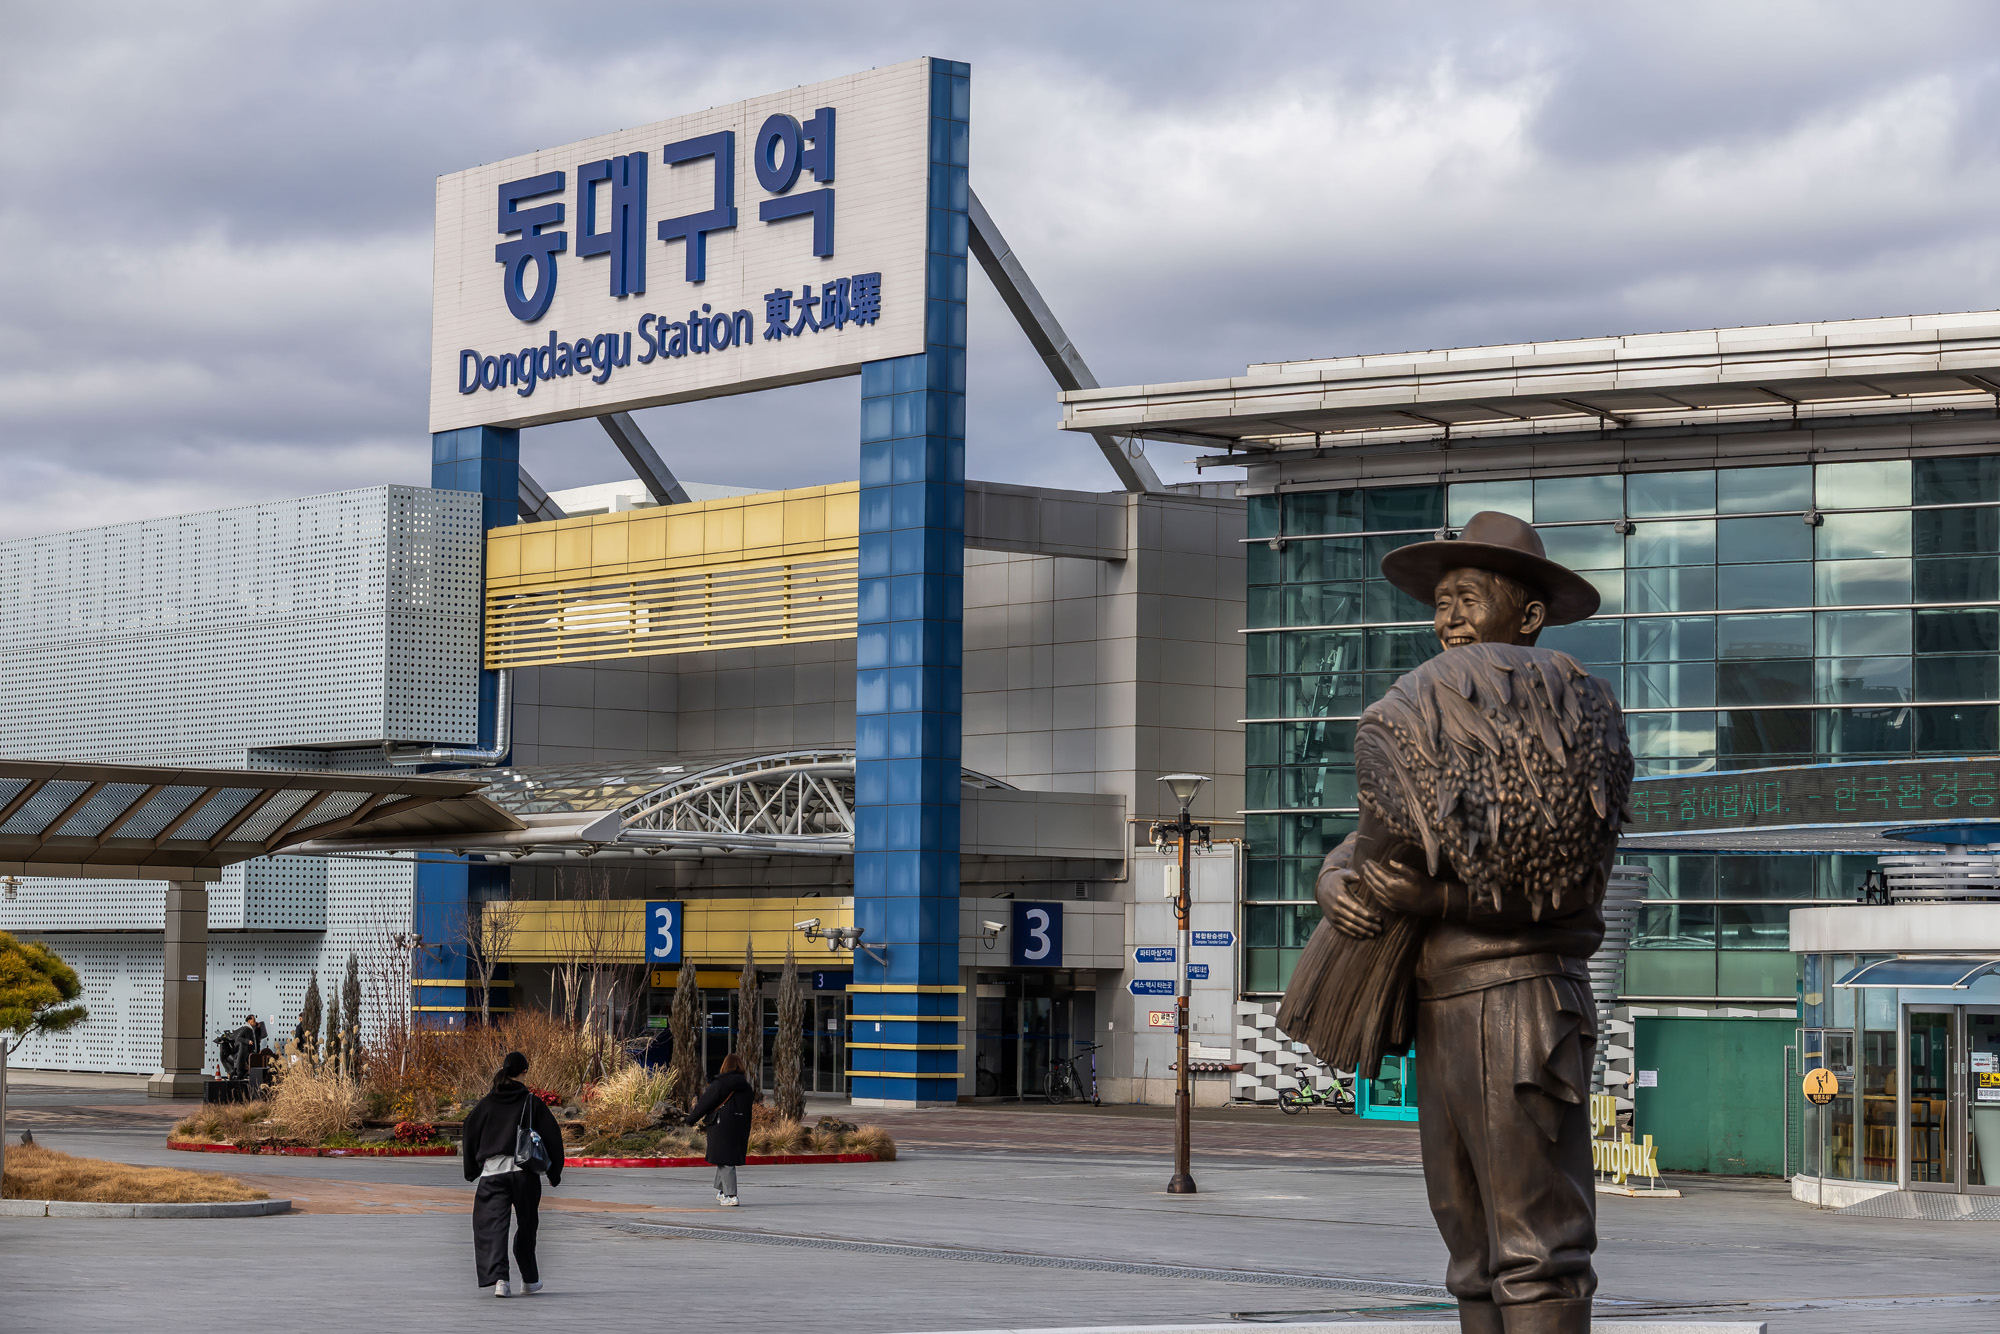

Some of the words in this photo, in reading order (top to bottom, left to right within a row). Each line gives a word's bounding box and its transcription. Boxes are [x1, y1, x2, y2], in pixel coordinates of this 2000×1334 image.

[495, 106, 836, 322] 동대구역
[459, 331, 631, 397] Dongdaegu
[637, 303, 753, 364] Station
[763, 272, 882, 340] 東大邱驛
[654, 907, 673, 958] 3
[1024, 908, 1050, 960] 3
[1140, 949, 1173, 957] 파티마삼거리
[656, 973, 661, 985] 3
[818, 973, 824, 988] 3
